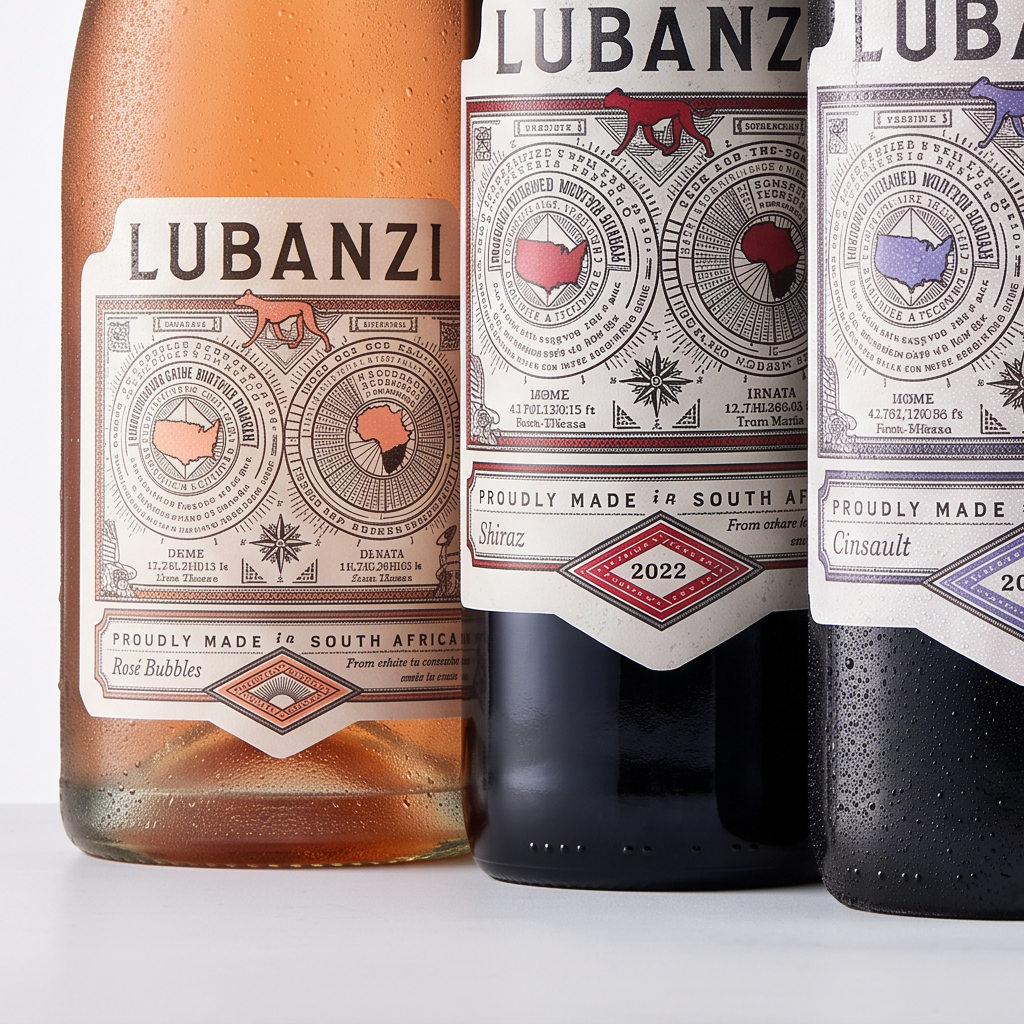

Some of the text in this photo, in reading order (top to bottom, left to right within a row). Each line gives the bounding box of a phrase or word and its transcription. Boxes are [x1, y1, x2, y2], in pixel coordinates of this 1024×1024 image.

[130, 222, 441, 281] LUBANZI
[746, 387, 797, 400] IRNATA
[585, 404, 596, 416] ft
[480, 490, 556, 507] PROUDLY
[571, 493, 635, 508] MADE
[693, 491, 771, 507] SOUTH
[832, 501, 920, 518] PROUDLY
[936, 502, 1004, 517] MADE
[725, 518, 761, 532] From
[479, 522, 525, 547] Shiraz
[834, 531, 911, 556] Cinsault
[631, 563, 686, 579] 2022
[114, 633, 191, 647] PROUDLY
[204, 635, 262, 649] MADE
[311, 635, 380, 648] SOUTH
[393, 633, 456, 647] AFRICA
[112, 657, 202, 677] Rosé Bubbles
[345, 657, 375, 669] From
